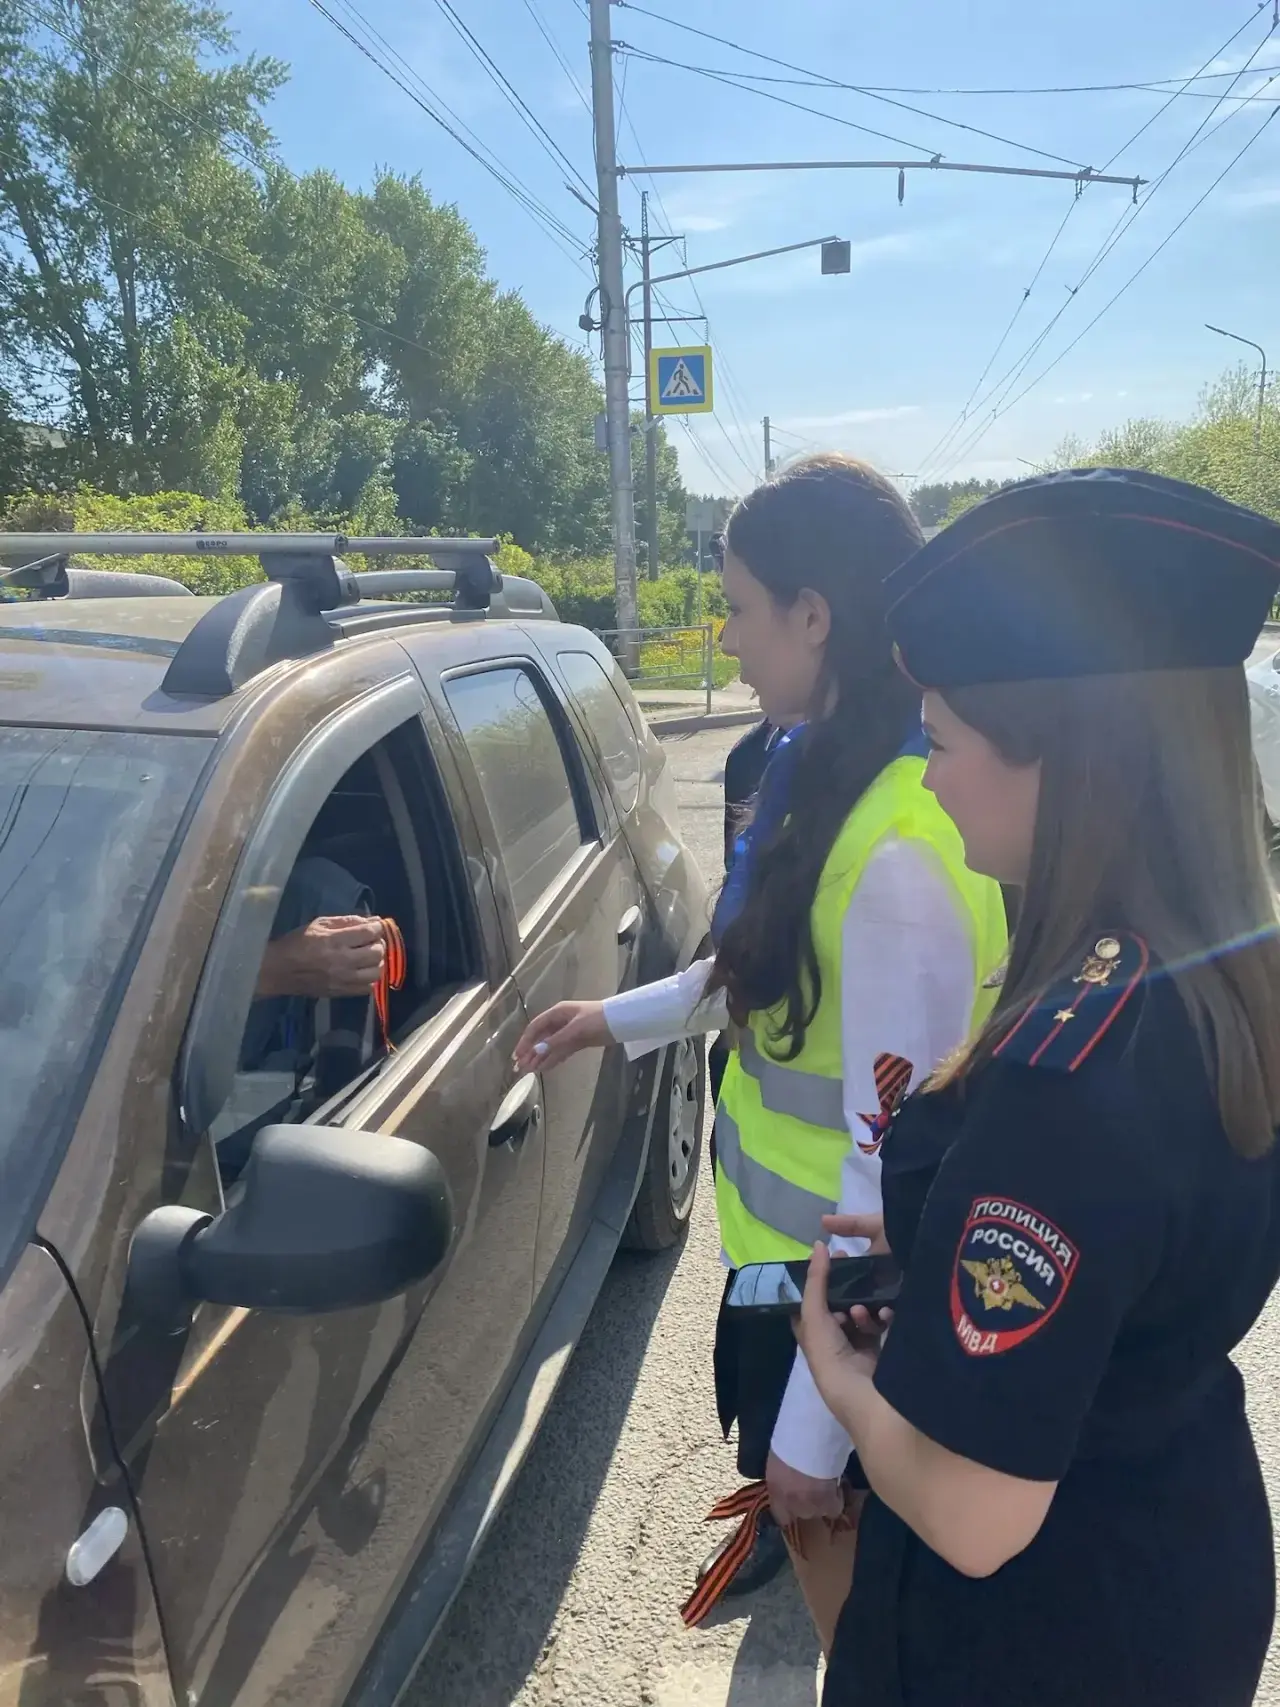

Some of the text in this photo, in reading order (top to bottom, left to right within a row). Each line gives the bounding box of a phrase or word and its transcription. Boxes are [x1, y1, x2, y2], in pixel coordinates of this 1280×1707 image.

[971, 1229, 1056, 1286] РОССИЯ
[974, 1201, 1072, 1267] ПОЛИЦИЯ
[957, 1314, 998, 1353] МВД
